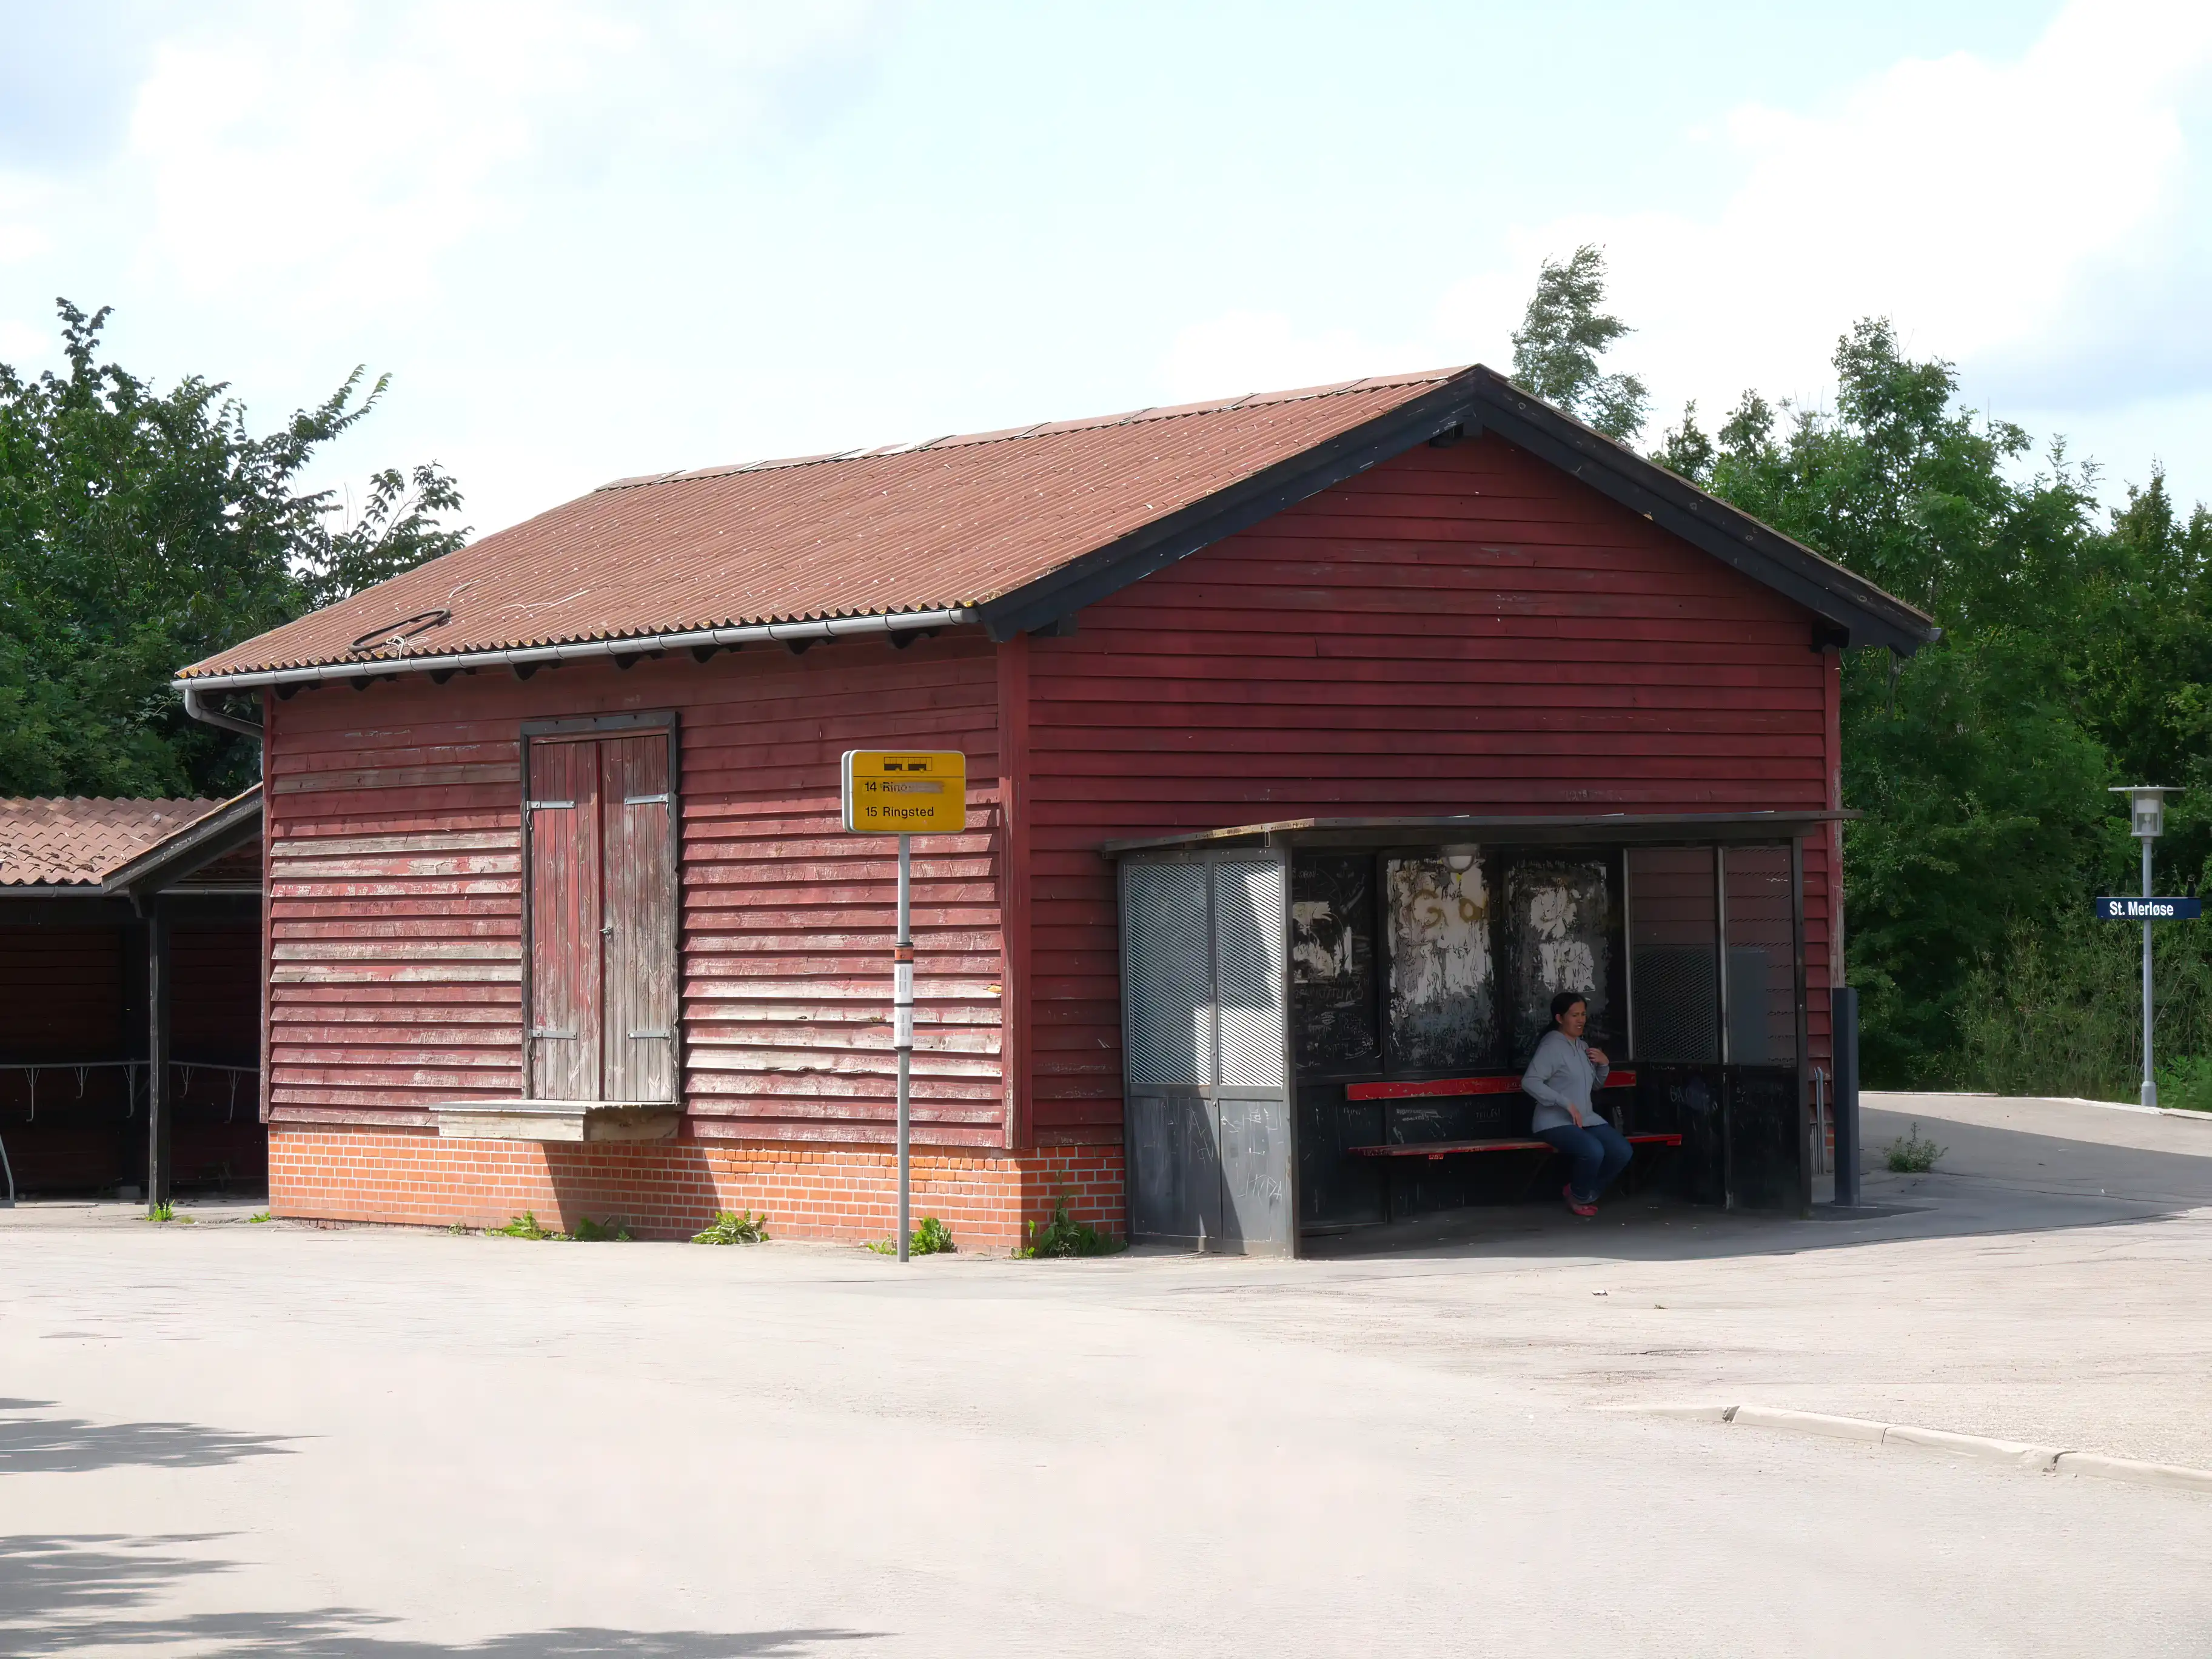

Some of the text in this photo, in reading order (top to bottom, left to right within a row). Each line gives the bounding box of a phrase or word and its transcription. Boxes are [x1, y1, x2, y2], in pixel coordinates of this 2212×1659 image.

[865, 782, 877, 792] 14
[865, 806, 934, 819] 15 Ringsted
[2110, 901, 2174, 916] St. Merløse
